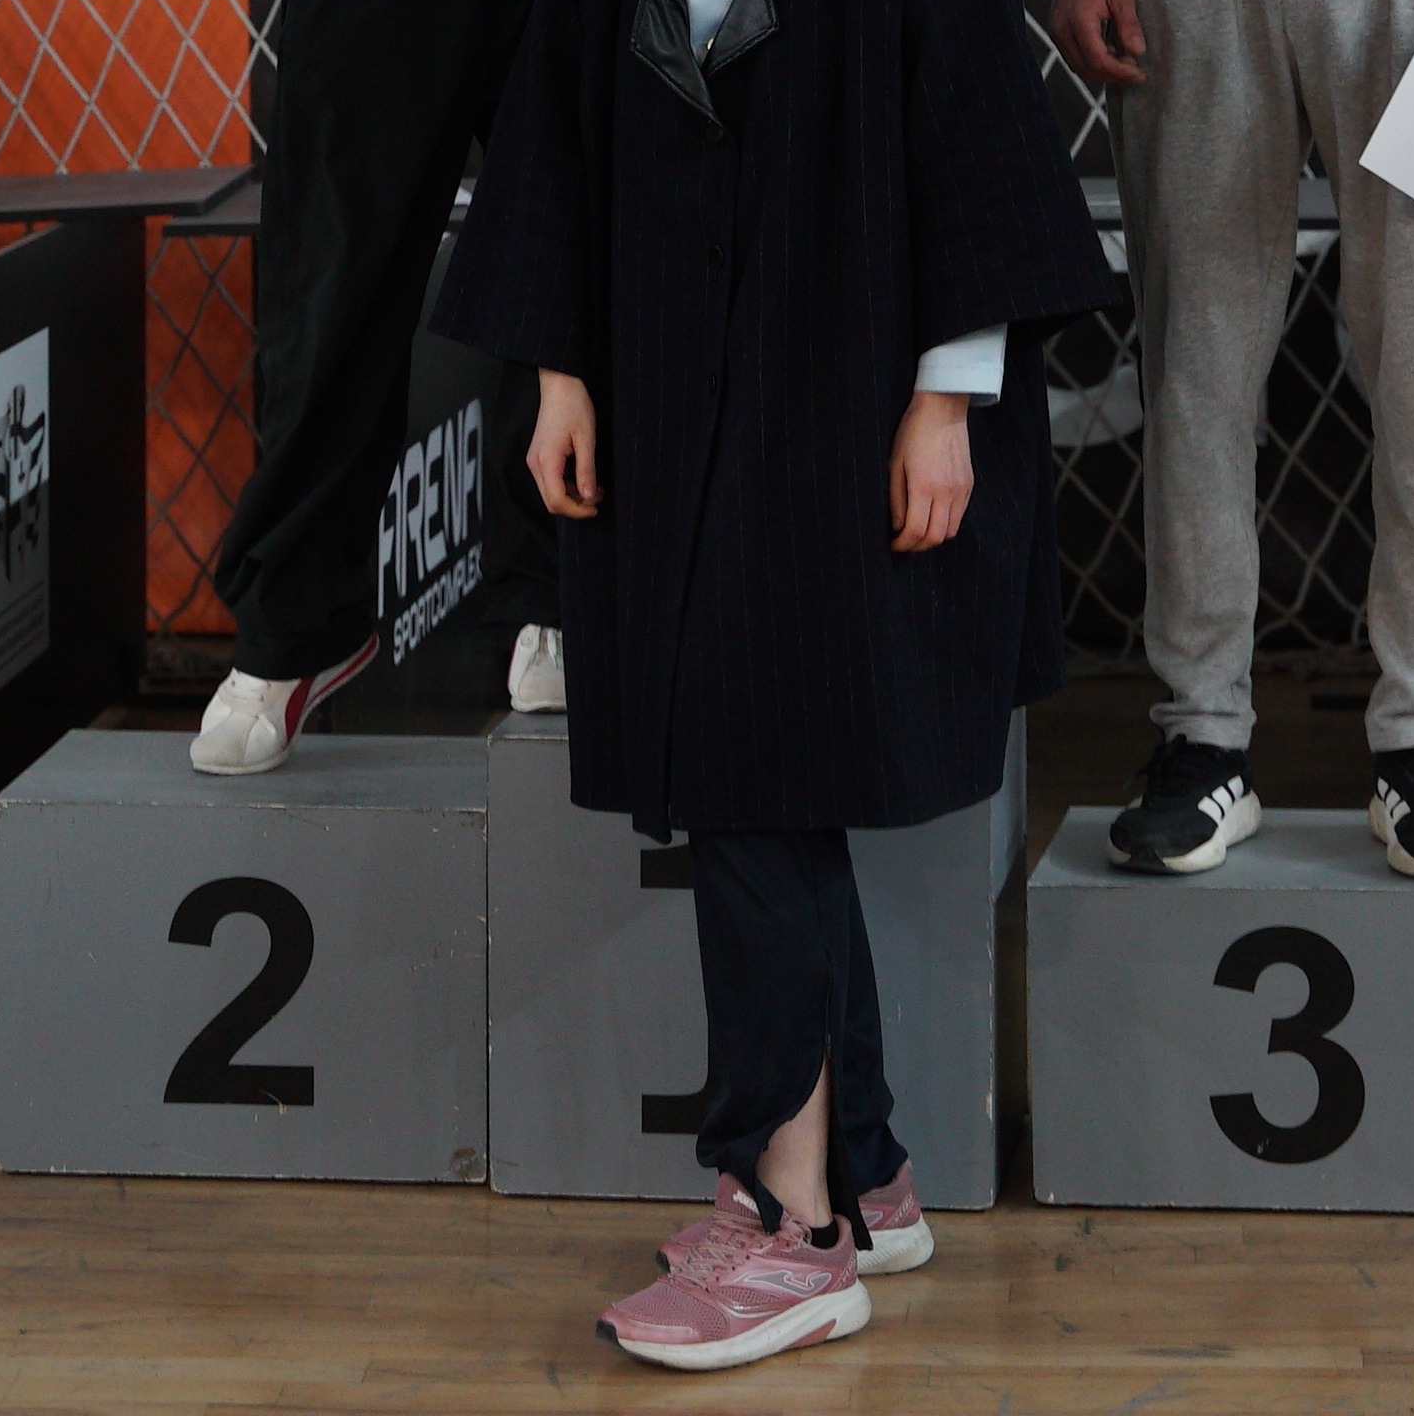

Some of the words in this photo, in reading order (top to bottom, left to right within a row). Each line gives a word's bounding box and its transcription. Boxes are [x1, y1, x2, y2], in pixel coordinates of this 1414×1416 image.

[377, 396, 483, 621] ARENA
[392, 541, 484, 667] SPORTCOMPLEX
[162, 875, 315, 1111] 2
[1208, 924, 1366, 1166] 3
